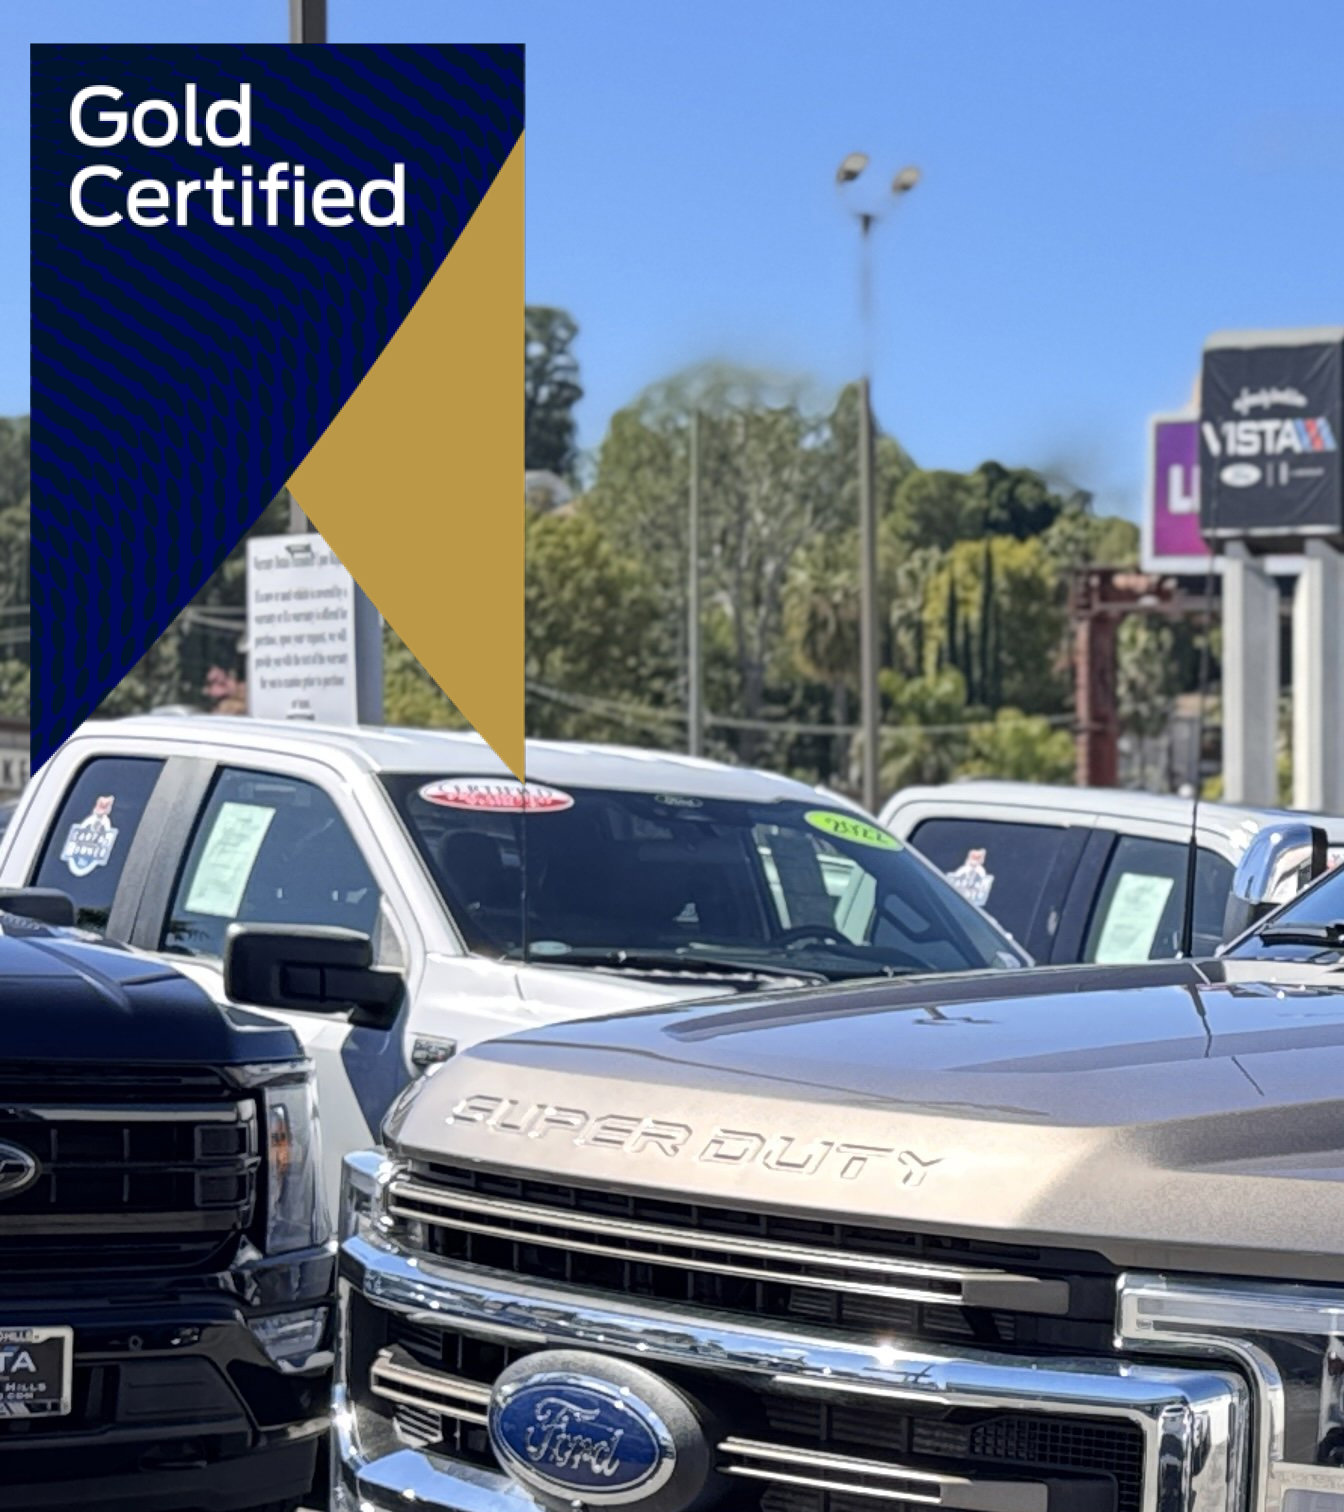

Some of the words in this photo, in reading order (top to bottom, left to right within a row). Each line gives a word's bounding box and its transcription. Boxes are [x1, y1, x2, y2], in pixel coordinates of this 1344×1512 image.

[446, 1093, 694, 1158] SUPER
[699, 1127, 943, 1188] DUTY
[524, 1394, 626, 1479] Ford
